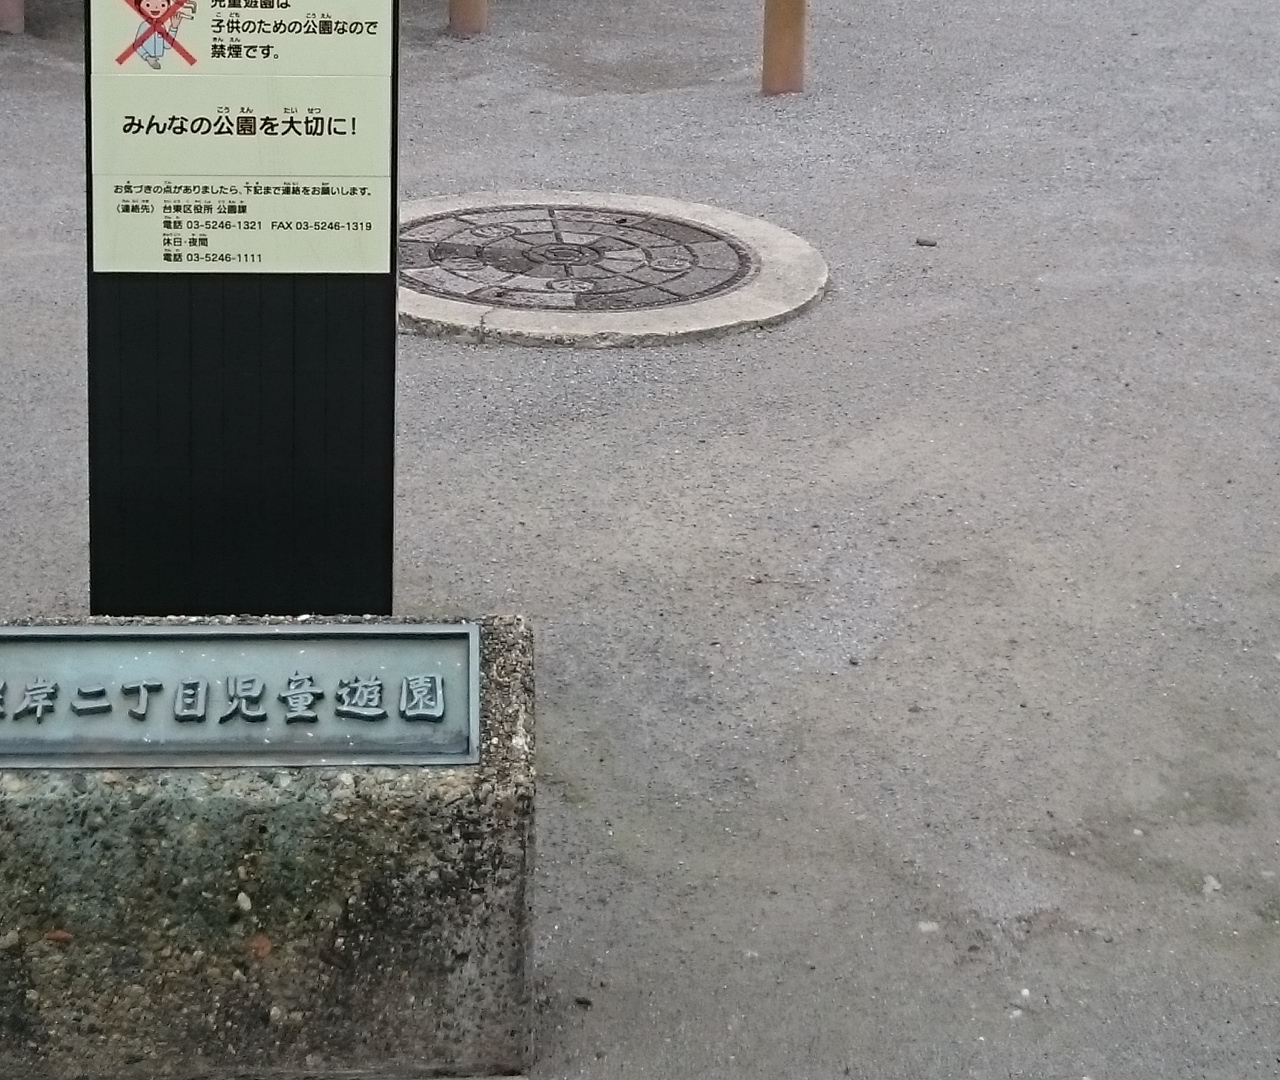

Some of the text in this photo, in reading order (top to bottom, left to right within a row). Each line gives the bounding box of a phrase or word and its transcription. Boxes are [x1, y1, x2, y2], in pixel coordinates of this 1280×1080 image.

[211, 19, 378, 35] 子供のための公園なので
[211, 44, 279, 59] 禁煙です。
[123, 115, 356, 136] みんなの公園を大切に!
[114, 184, 371, 196] お気づきの点がありましたら、下記まで連絡をお願いします。
[163, 204, 213, 214] 台東区役所
[217, 205, 247, 214] 公園課
[163, 220, 372, 231] 電話 03-5246-1321 FAX 03-5246-1319
[163, 253, 261, 262] 電話 03-5246-1111
